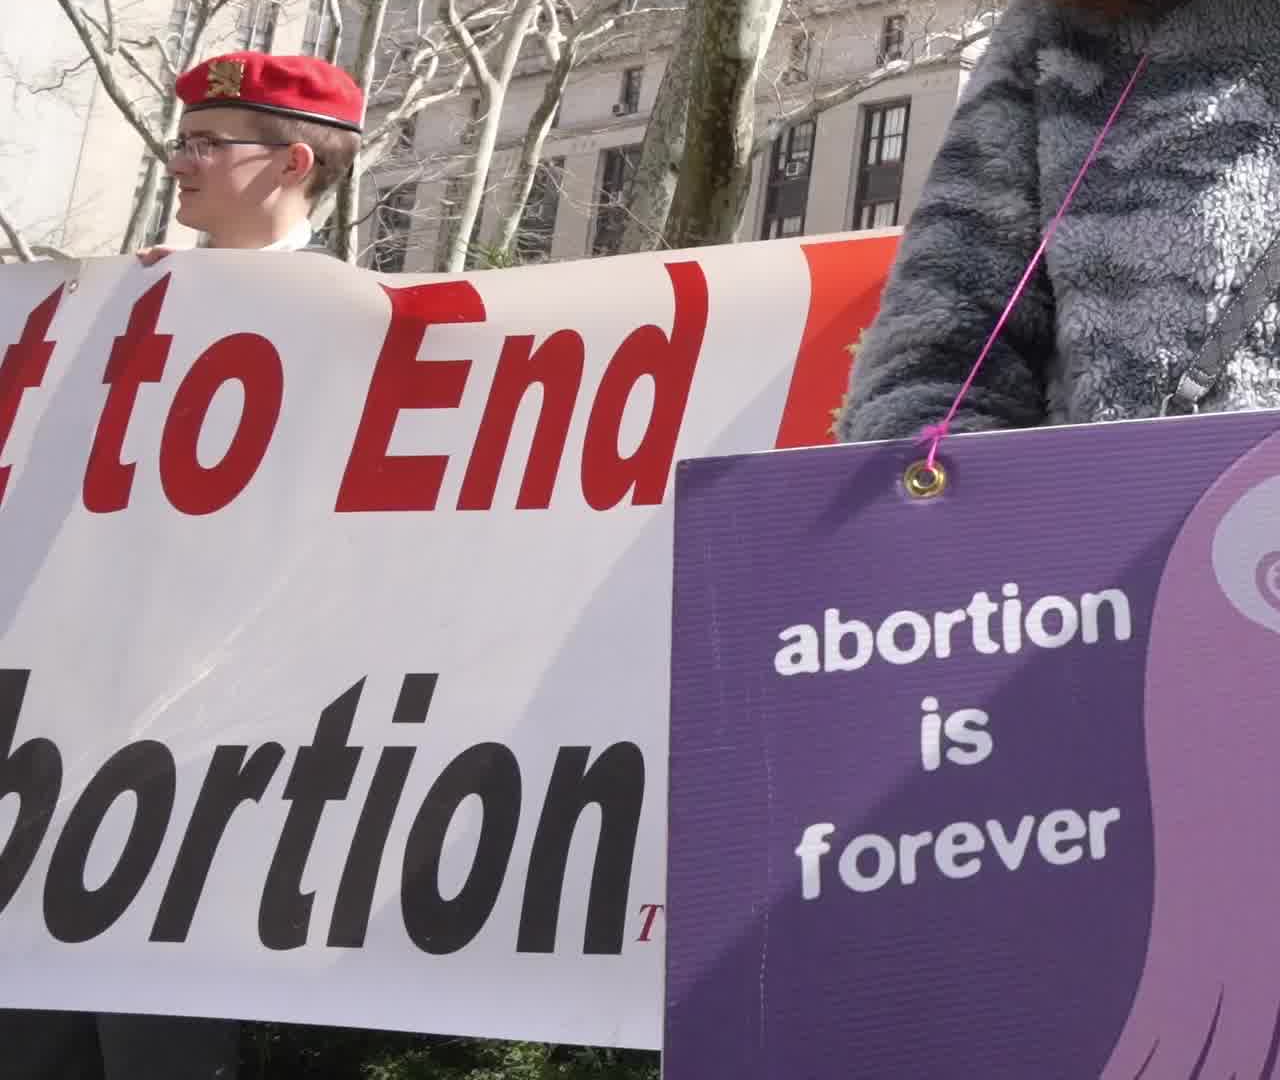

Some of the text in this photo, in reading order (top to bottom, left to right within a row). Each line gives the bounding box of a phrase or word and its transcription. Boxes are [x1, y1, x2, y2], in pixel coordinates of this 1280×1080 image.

[82, 271, 284, 515] to
[335, 260, 708, 513] End
[774, 582, 1131, 676] abortion
[920, 695, 993, 771] is
[794, 807, 1121, 900] forever
